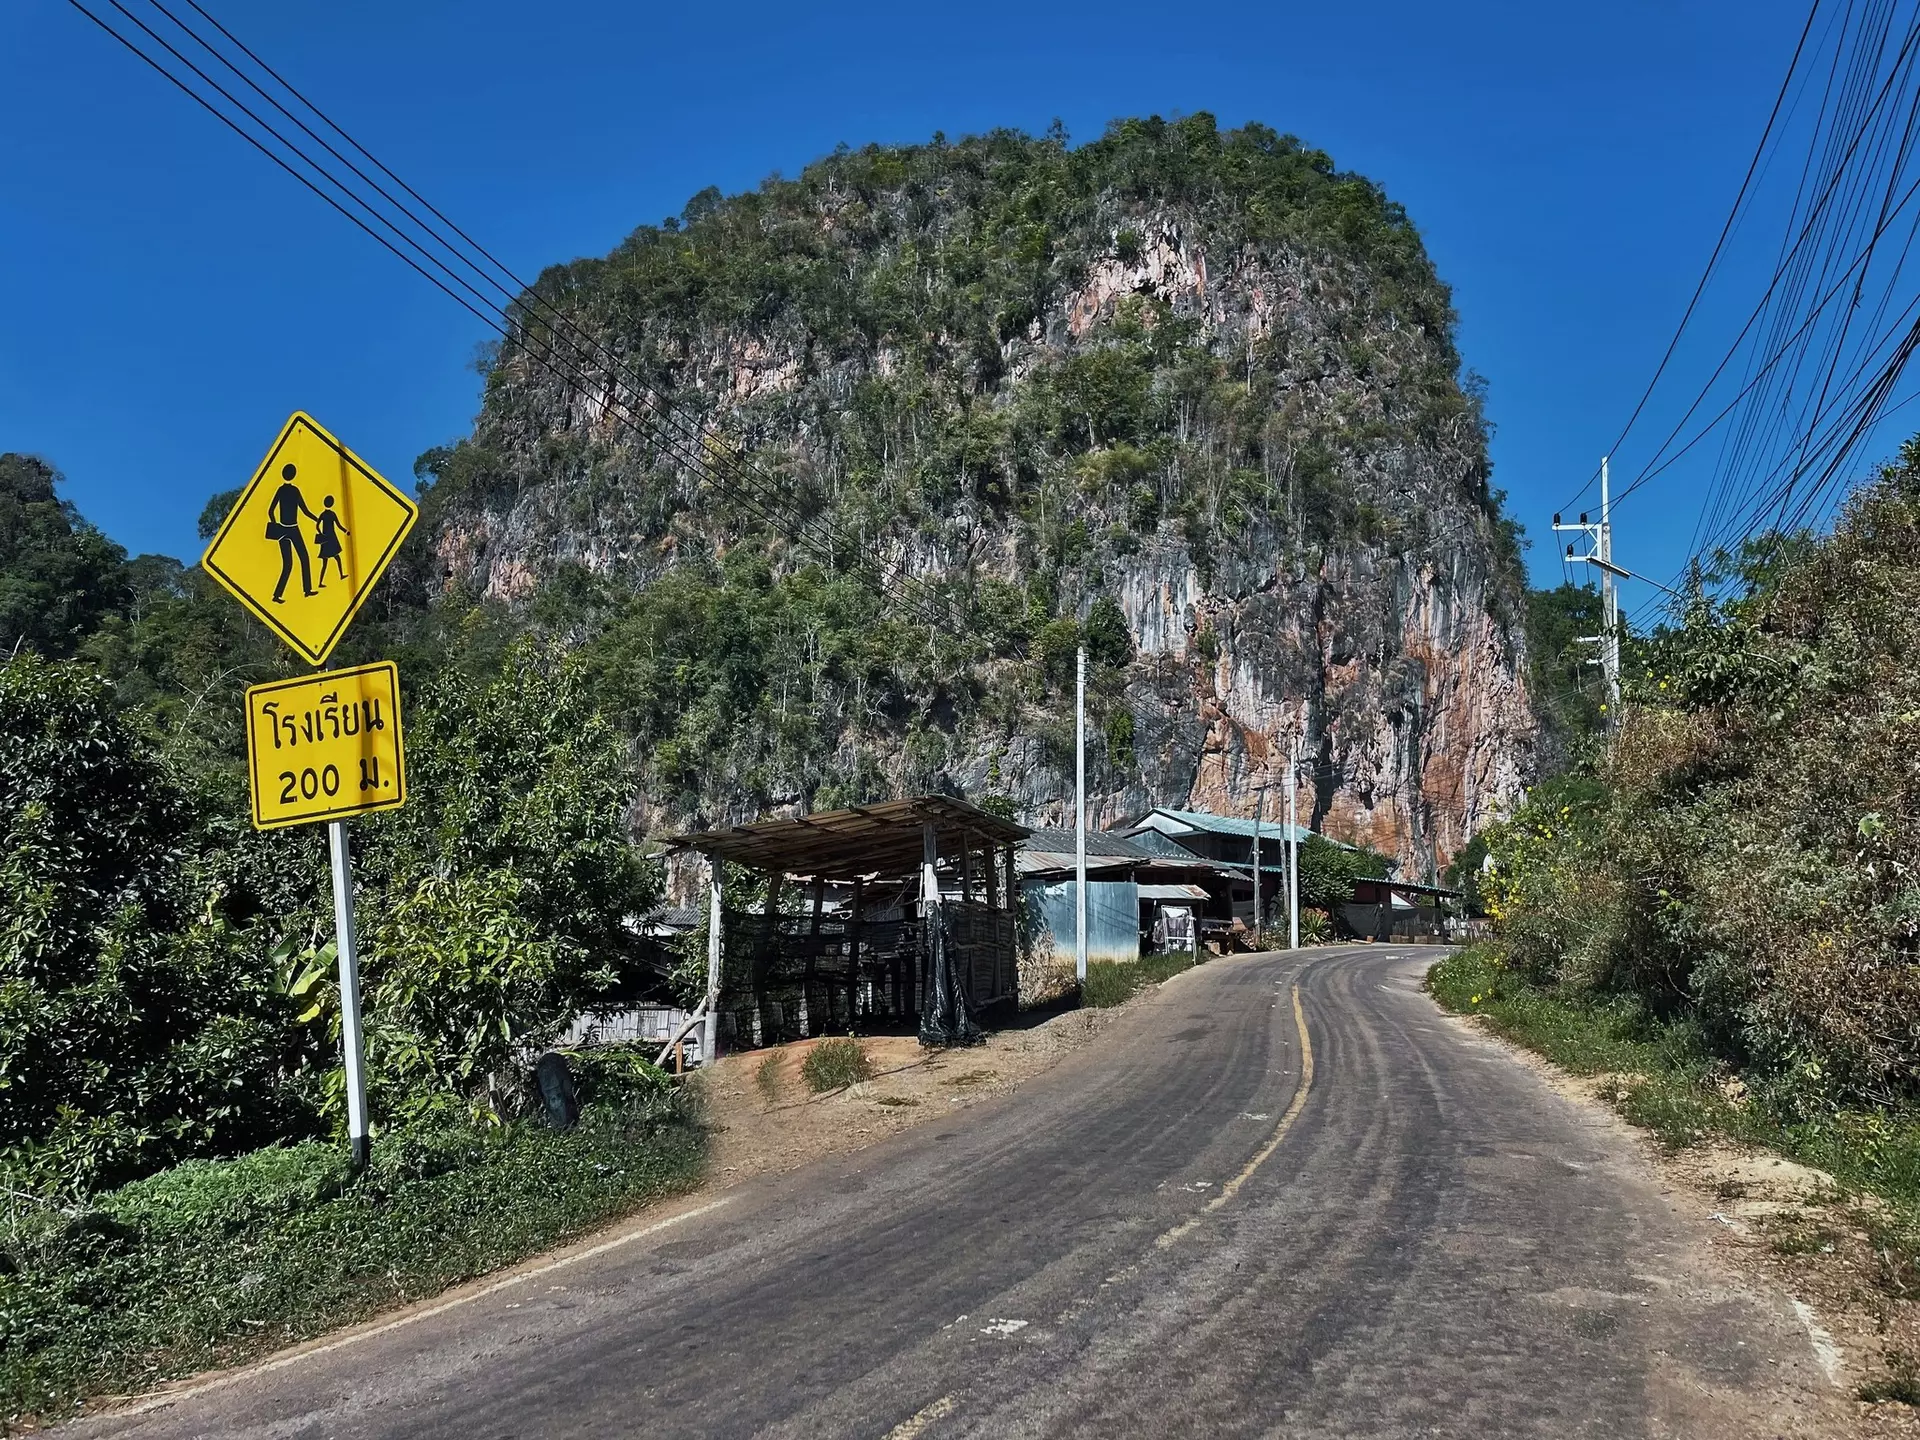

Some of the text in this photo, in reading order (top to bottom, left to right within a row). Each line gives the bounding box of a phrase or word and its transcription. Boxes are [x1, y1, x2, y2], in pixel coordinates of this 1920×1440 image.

[263, 692, 384, 749] โรงเรียน
[279, 756, 390, 805] 200 ม.
